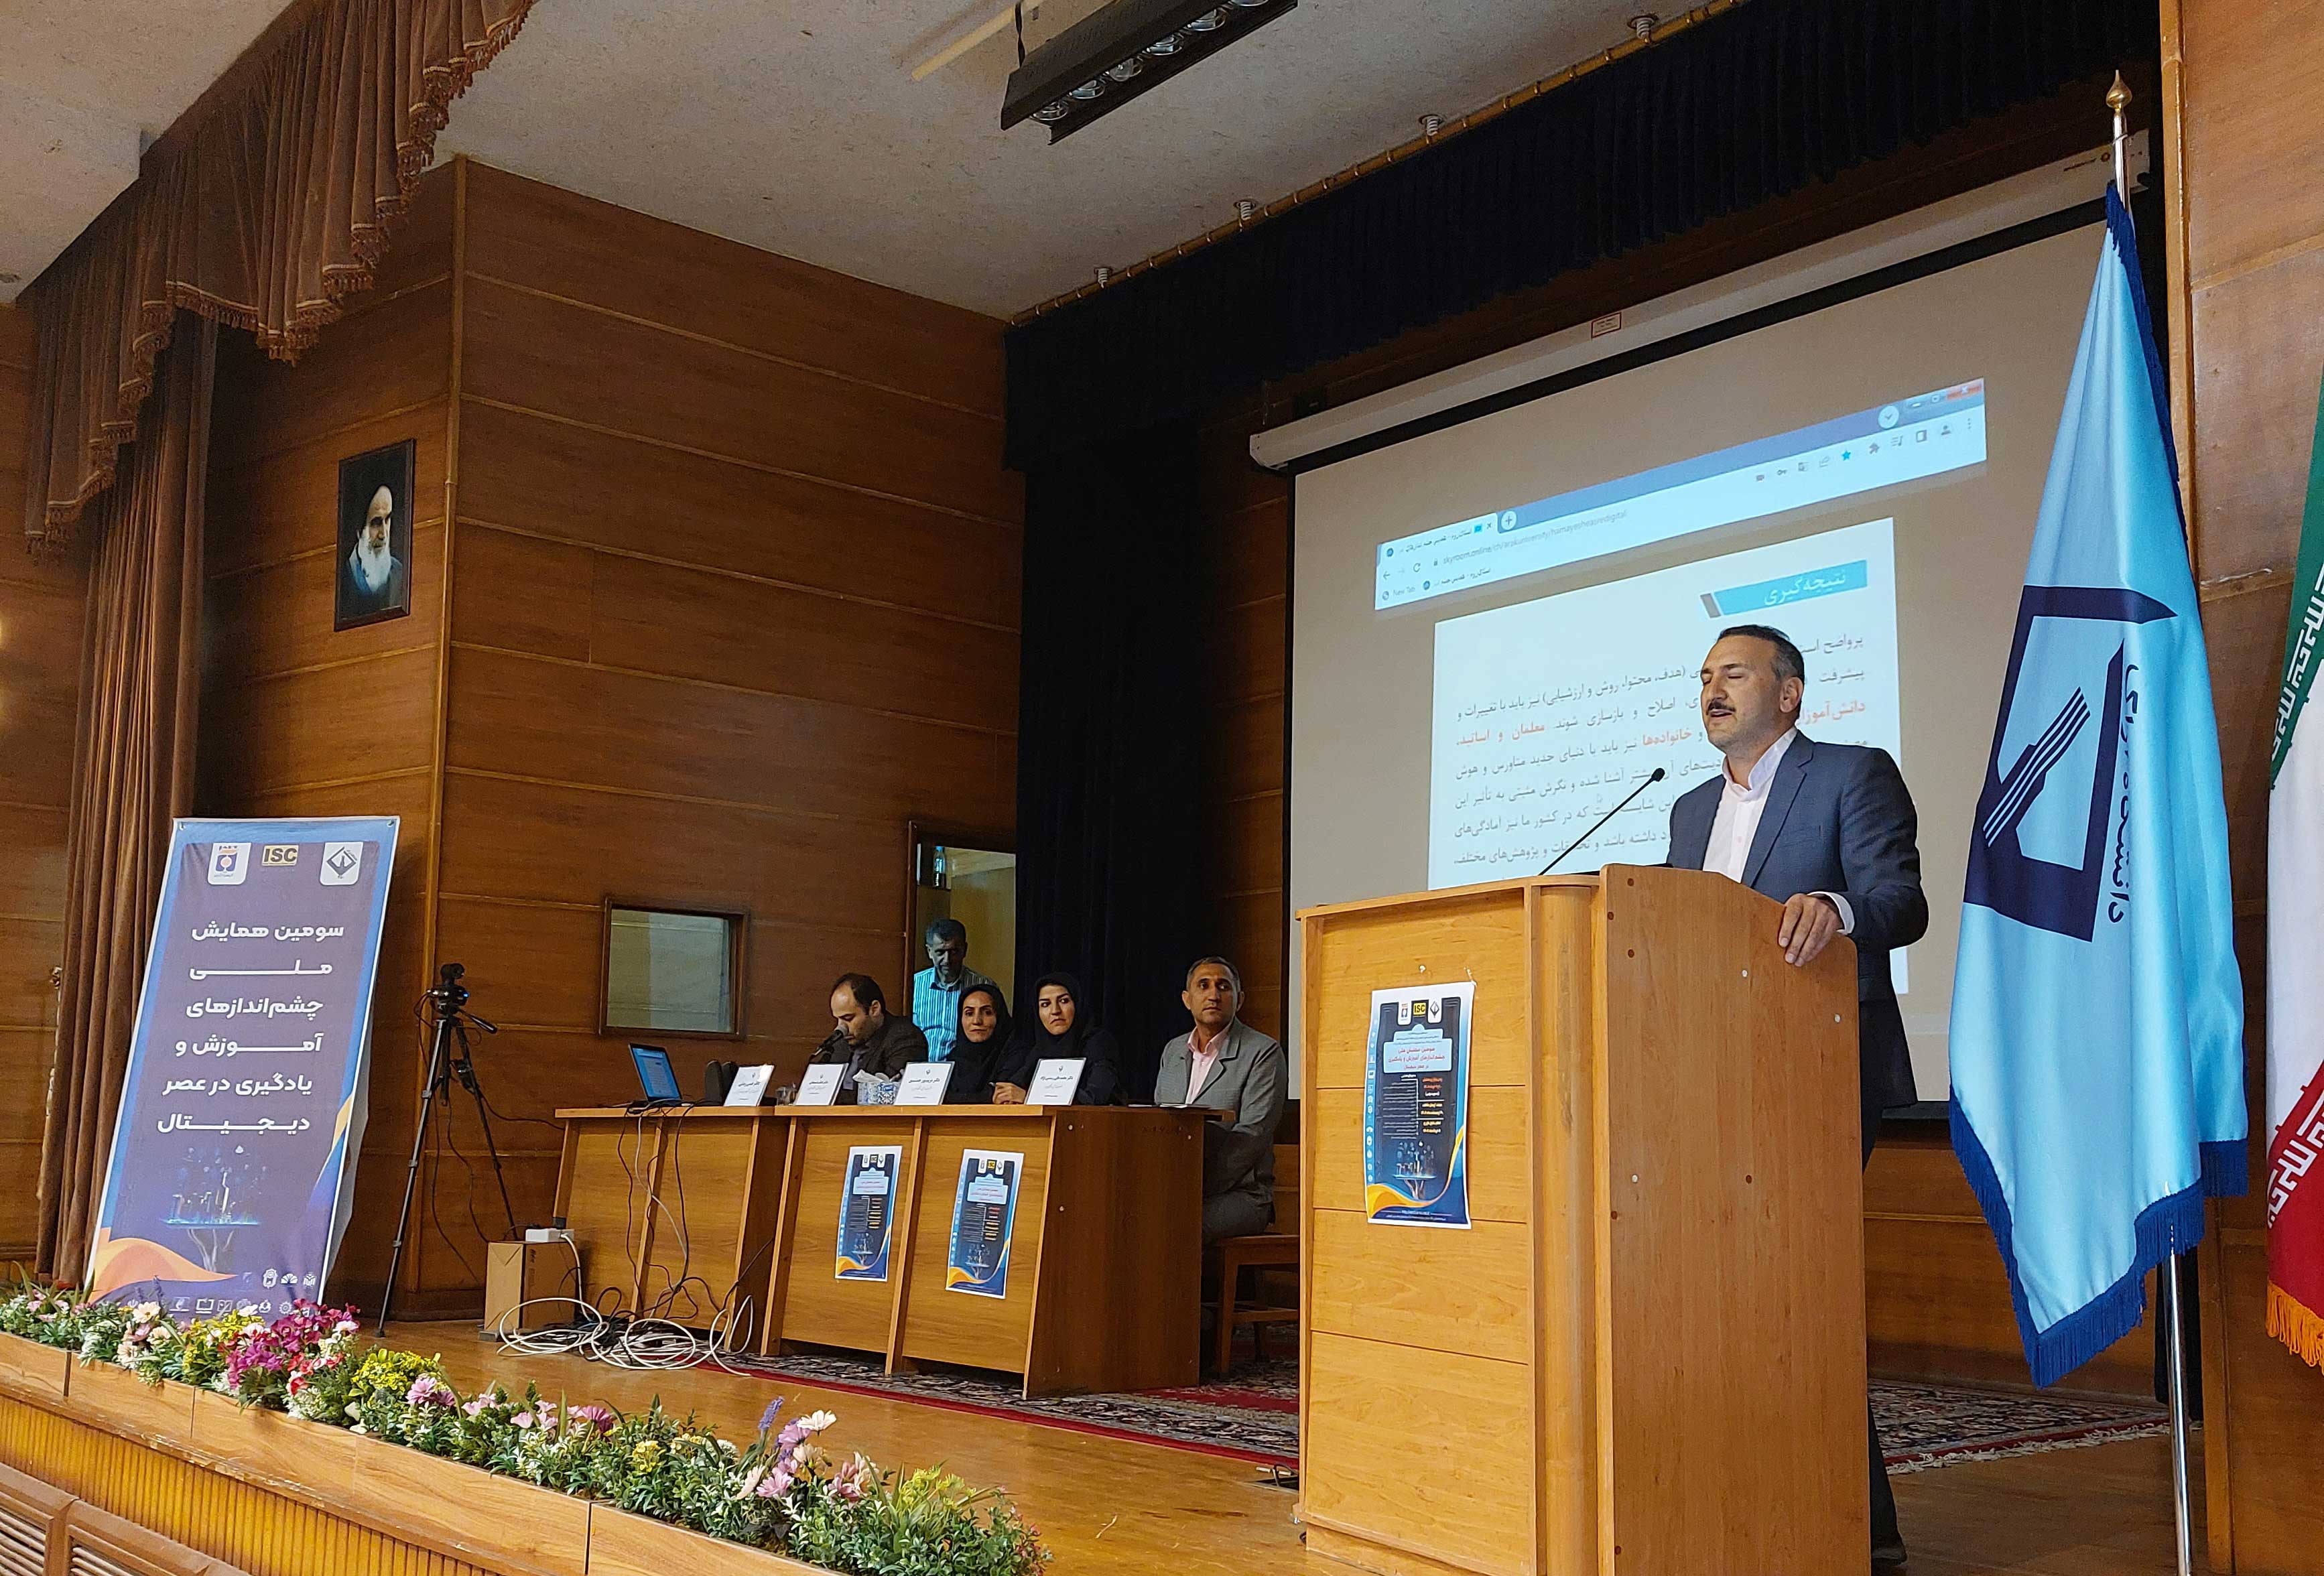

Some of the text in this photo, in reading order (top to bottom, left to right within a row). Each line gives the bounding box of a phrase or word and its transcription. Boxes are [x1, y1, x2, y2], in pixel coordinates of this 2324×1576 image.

[1819, 667, 1864, 684] پیشرفت
[1588, 688, 1592, 698] و
[1596, 681, 1618, 696] روش
[1508, 696, 1524, 709] باید
[1527, 695, 1540, 709] نیز
[1648, 697, 1675, 717] اصلاح
[1465, 703, 1497, 718] تغییرات
[1587, 706, 1624, 726] بازسازی
[1633, 710, 1638, 720] و
[1797, 700, 1866, 725] دانش‌آموزا
[1498, 732, 1503, 742] و
[1512, 722, 1545, 740] معلمان
[1601, 740, 1618, 753] باید
[1624, 739, 1637, 753] نیز
[1530, 754, 1555, 767] جدید
[1559, 746, 1584, 763] دنیای
[1483, 766, 1487, 775] و
[1604, 768, 1624, 783] آشنا
[1579, 774, 1600, 787] شده
[1539, 779, 1567, 797] نگرش
[1571, 783, 1575, 793] و
[1455, 792, 1470, 809] این
[1496, 791, 1504, 801] به
[1562, 811, 1572, 825] در
[1577, 805, 1589, 817] که
[1521, 814, 1531, 826] ما
[1534, 809, 1559, 829] کشور
[1604, 833, 1625, 846] باشد
[1629, 830, 1657, 844] داشته
[1543, 848, 1547, 858] و
[1594, 842, 1599, 852] و
[263, 848, 298, 863] ISC
[192, 920, 344, 942] سومین همایش
[186, 995, 324, 1021] چشم‌اندازهای
[1414, 1004, 1425, 1013] ISC
[175, 1033, 324, 1057] آموزش و
[162, 1072, 313, 1096] یادگیری در عصر
[157, 1113, 310, 1135] دیجیتال
